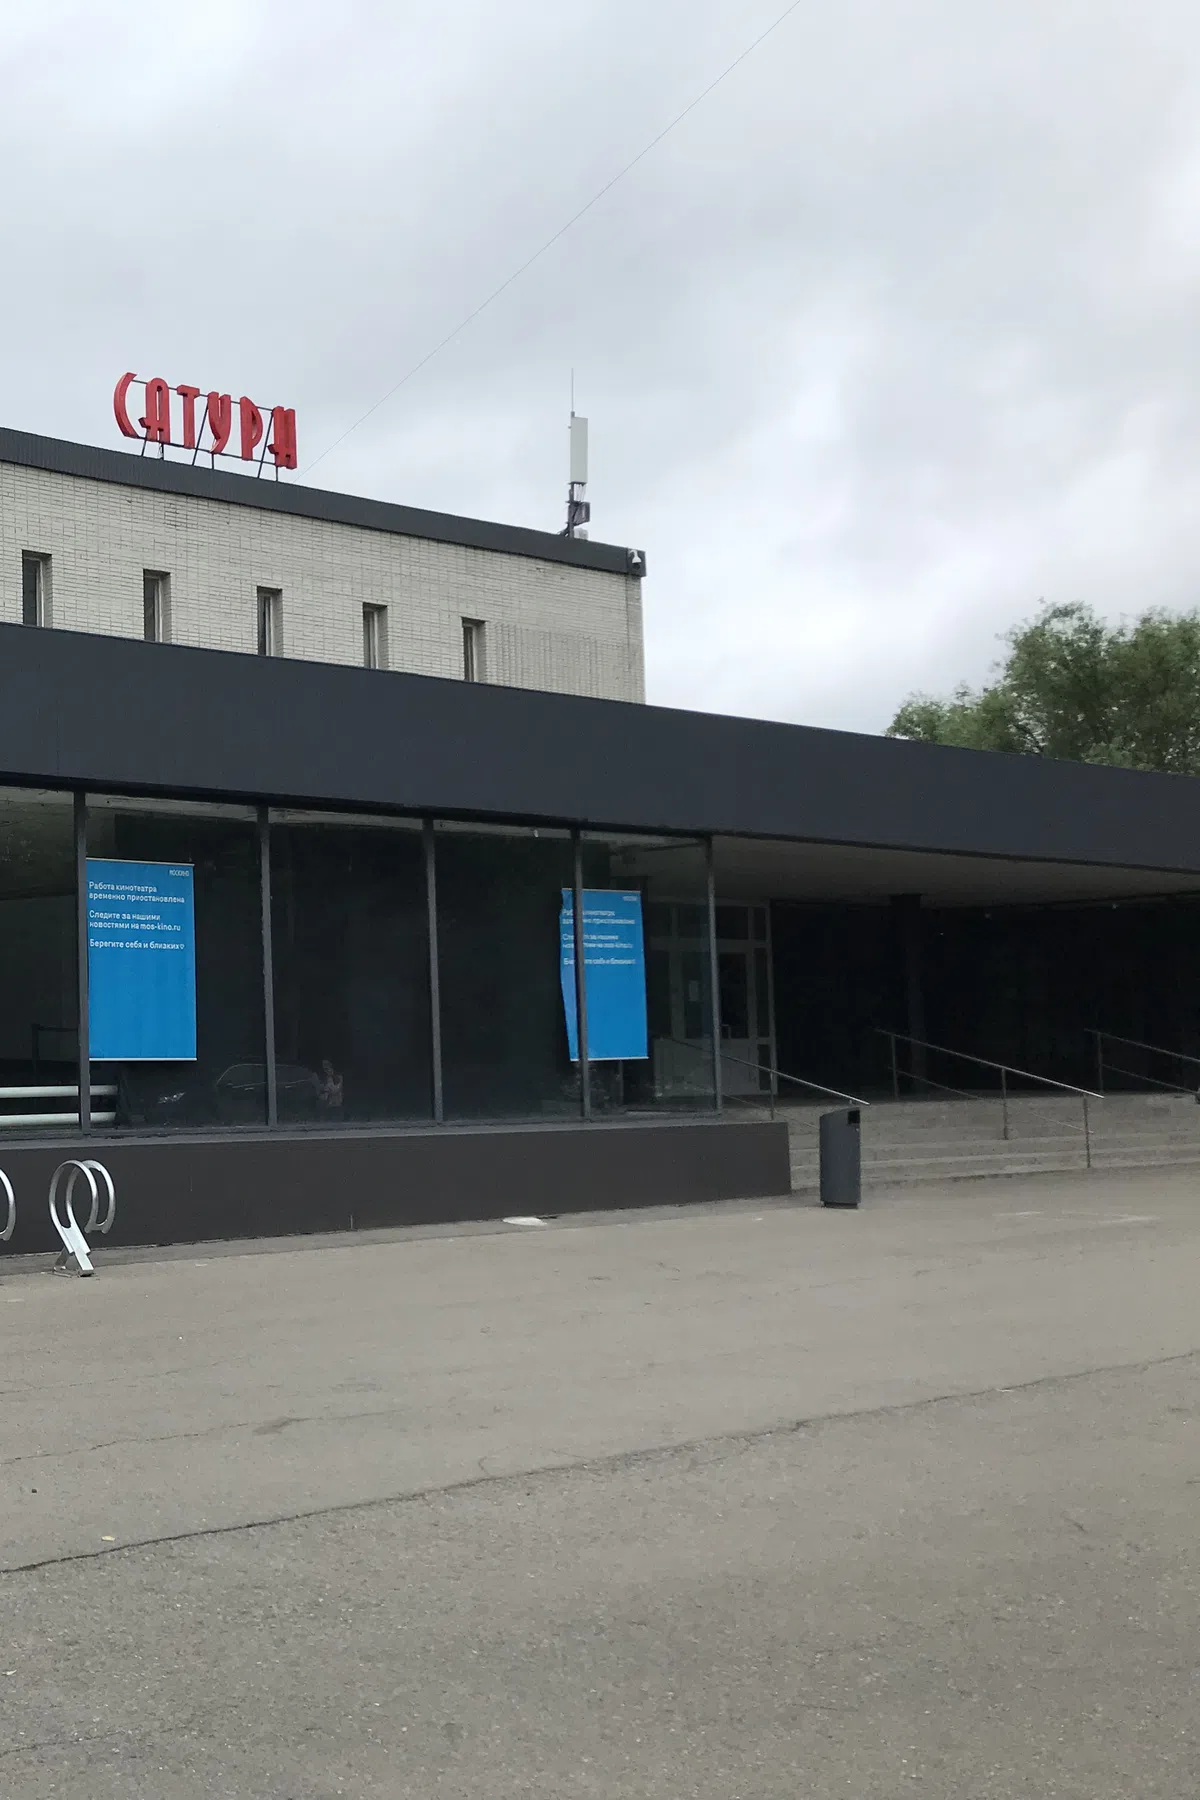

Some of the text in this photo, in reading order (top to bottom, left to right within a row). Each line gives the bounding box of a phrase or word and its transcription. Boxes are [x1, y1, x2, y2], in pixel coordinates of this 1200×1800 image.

[113, 372, 298, 470] САТУРН
[88, 881, 157, 893] Работа кинотеатра
[88, 892, 185, 903] временно приостановлена
[89, 910, 120, 920] Следите
[132, 913, 161, 921] нашими
[89, 921, 181, 931] новостями на mos-kino.ru
[89, 938, 124, 948] Берегите
[125, 940, 142, 948] себя
[149, 940, 180, 950] близких
